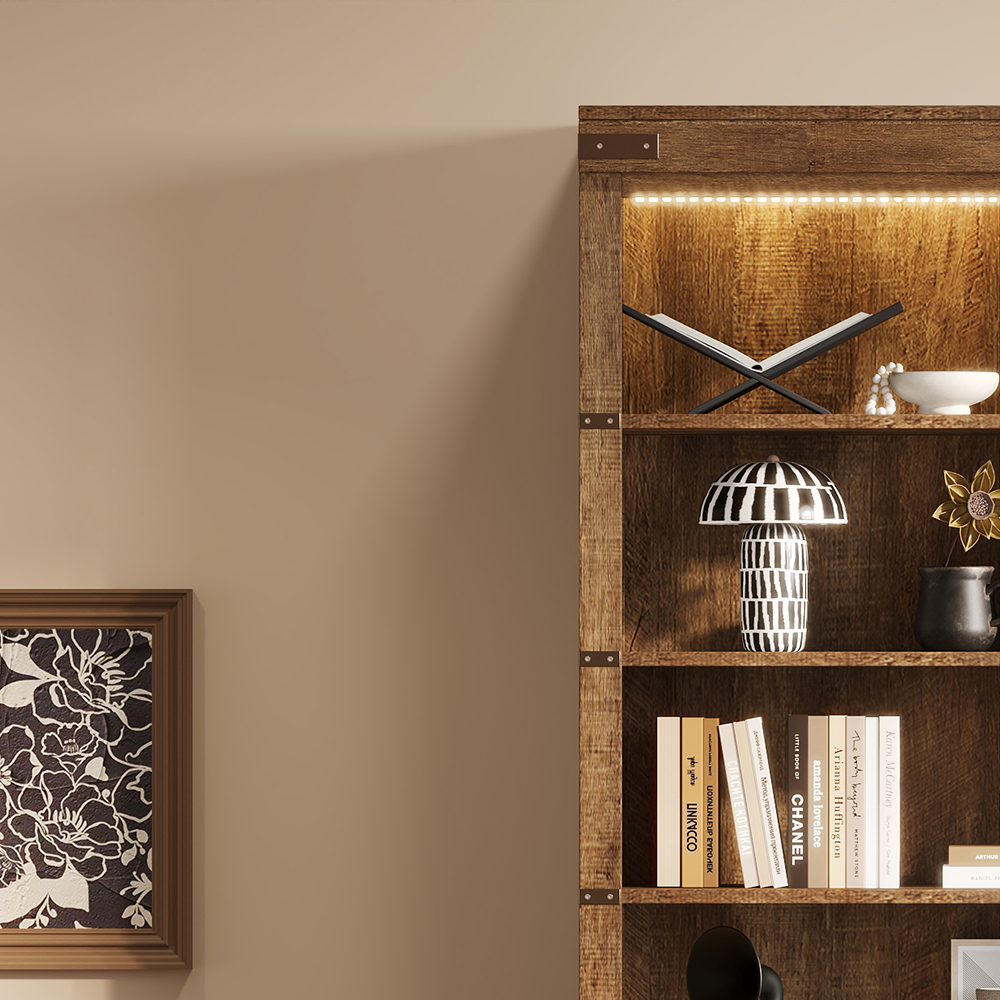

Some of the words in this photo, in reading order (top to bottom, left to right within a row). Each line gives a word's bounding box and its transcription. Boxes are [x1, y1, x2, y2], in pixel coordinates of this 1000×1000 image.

[885, 731, 896, 757] Karen
[794, 771, 800, 780] OF
[813, 760, 824, 802] amanda
[834, 747, 844, 791] Arianna
[882, 760, 896, 809] McCartney
[726, 760, 744, 807] СПАСИТЕ
[735, 809, 752, 856] КОТИКА!
[791, 794, 804, 866] CHANEL
[813, 804, 824, 848] lovelace
[831, 796, 844, 859] Huffington
